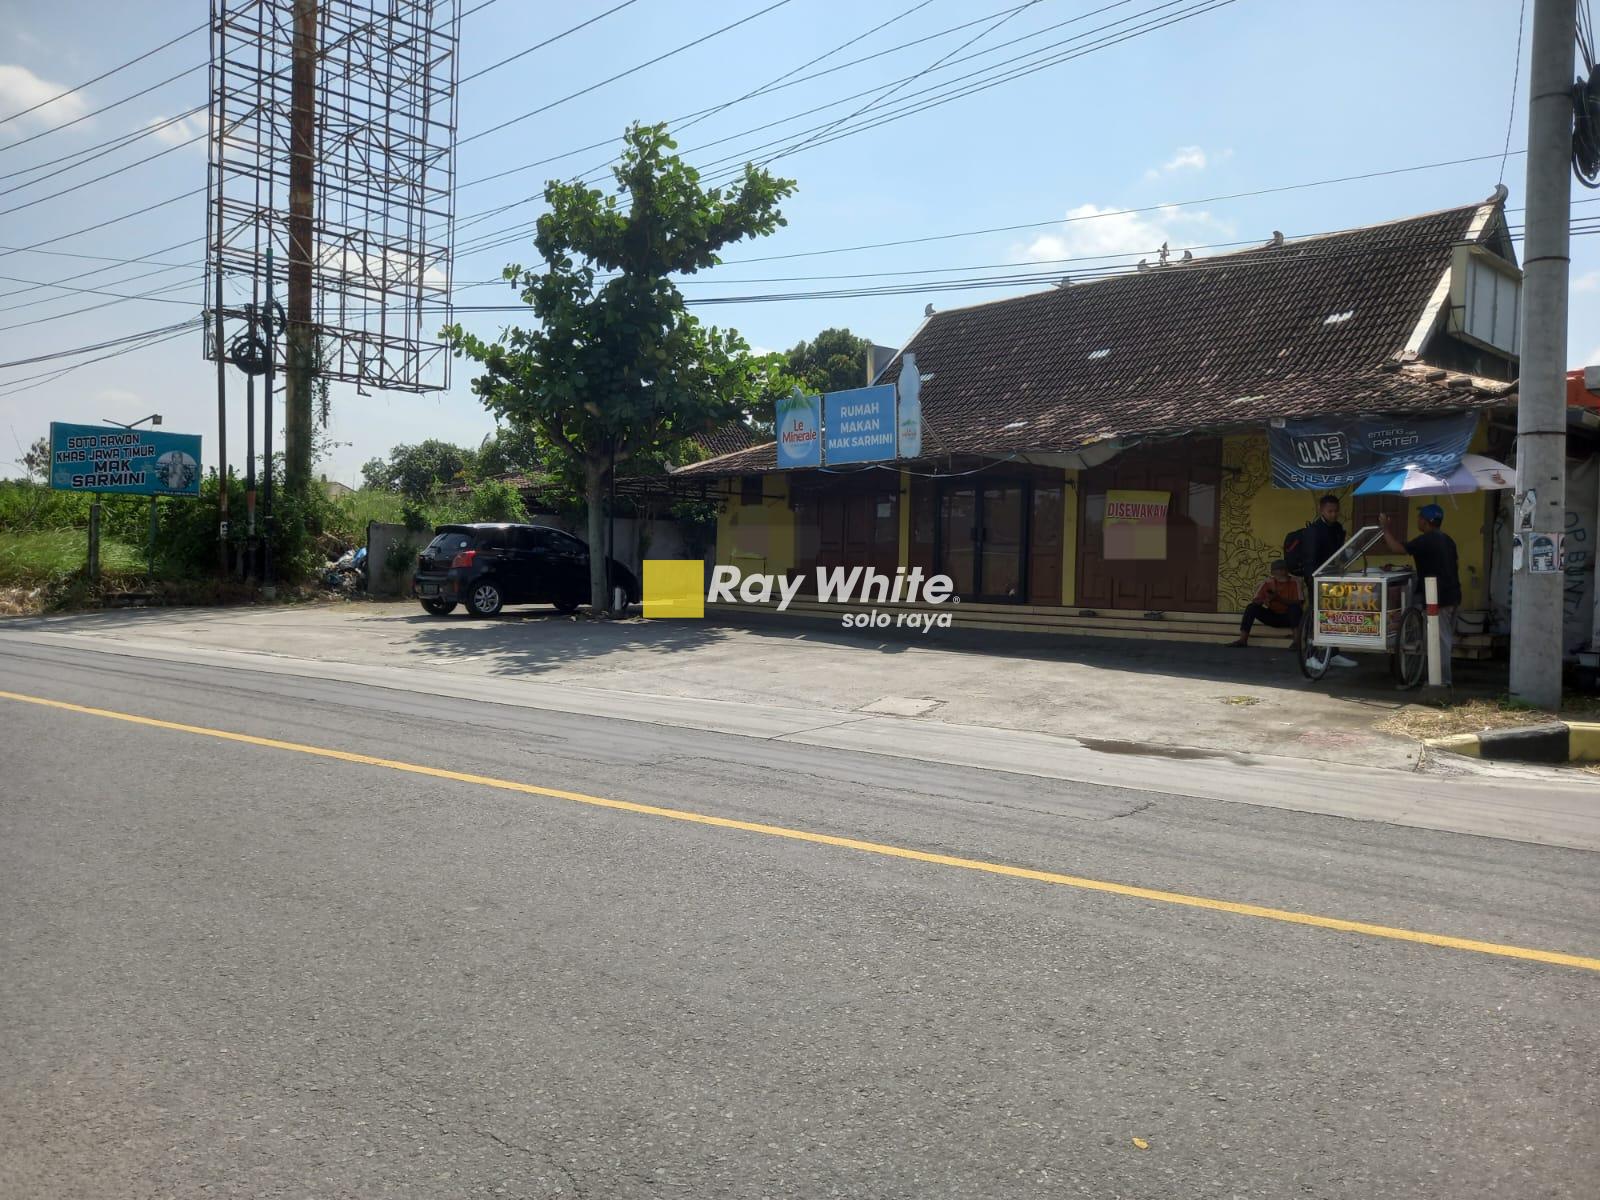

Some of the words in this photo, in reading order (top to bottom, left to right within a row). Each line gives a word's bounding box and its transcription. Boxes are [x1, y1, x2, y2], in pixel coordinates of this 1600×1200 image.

[840, 402, 880, 418] RUMAH
[793, 419, 804, 431] Le
[840, 419, 880, 433] MAKAN
[68, 437, 97, 448] SOTO
[100, 434, 140, 446] RAWON
[782, 428, 817, 443] Minerale
[828, 437, 850, 449] MAK
[851, 433, 893, 447] SARMINI
[1373, 435, 1419, 449] PATEN
[56, 451, 85, 463] KHAS
[89, 448, 120, 461] JAWA
[122, 445, 155, 458] TIMUR
[1297, 438, 1330, 463] CLAS
[1328, 436, 1344, 461] MILD
[94, 460, 131, 473] MAK
[72, 472, 145, 488] SARMINI
[1290, 474, 1355, 483] SILVER
[1107, 502, 1168, 518] DISEWAKAN
